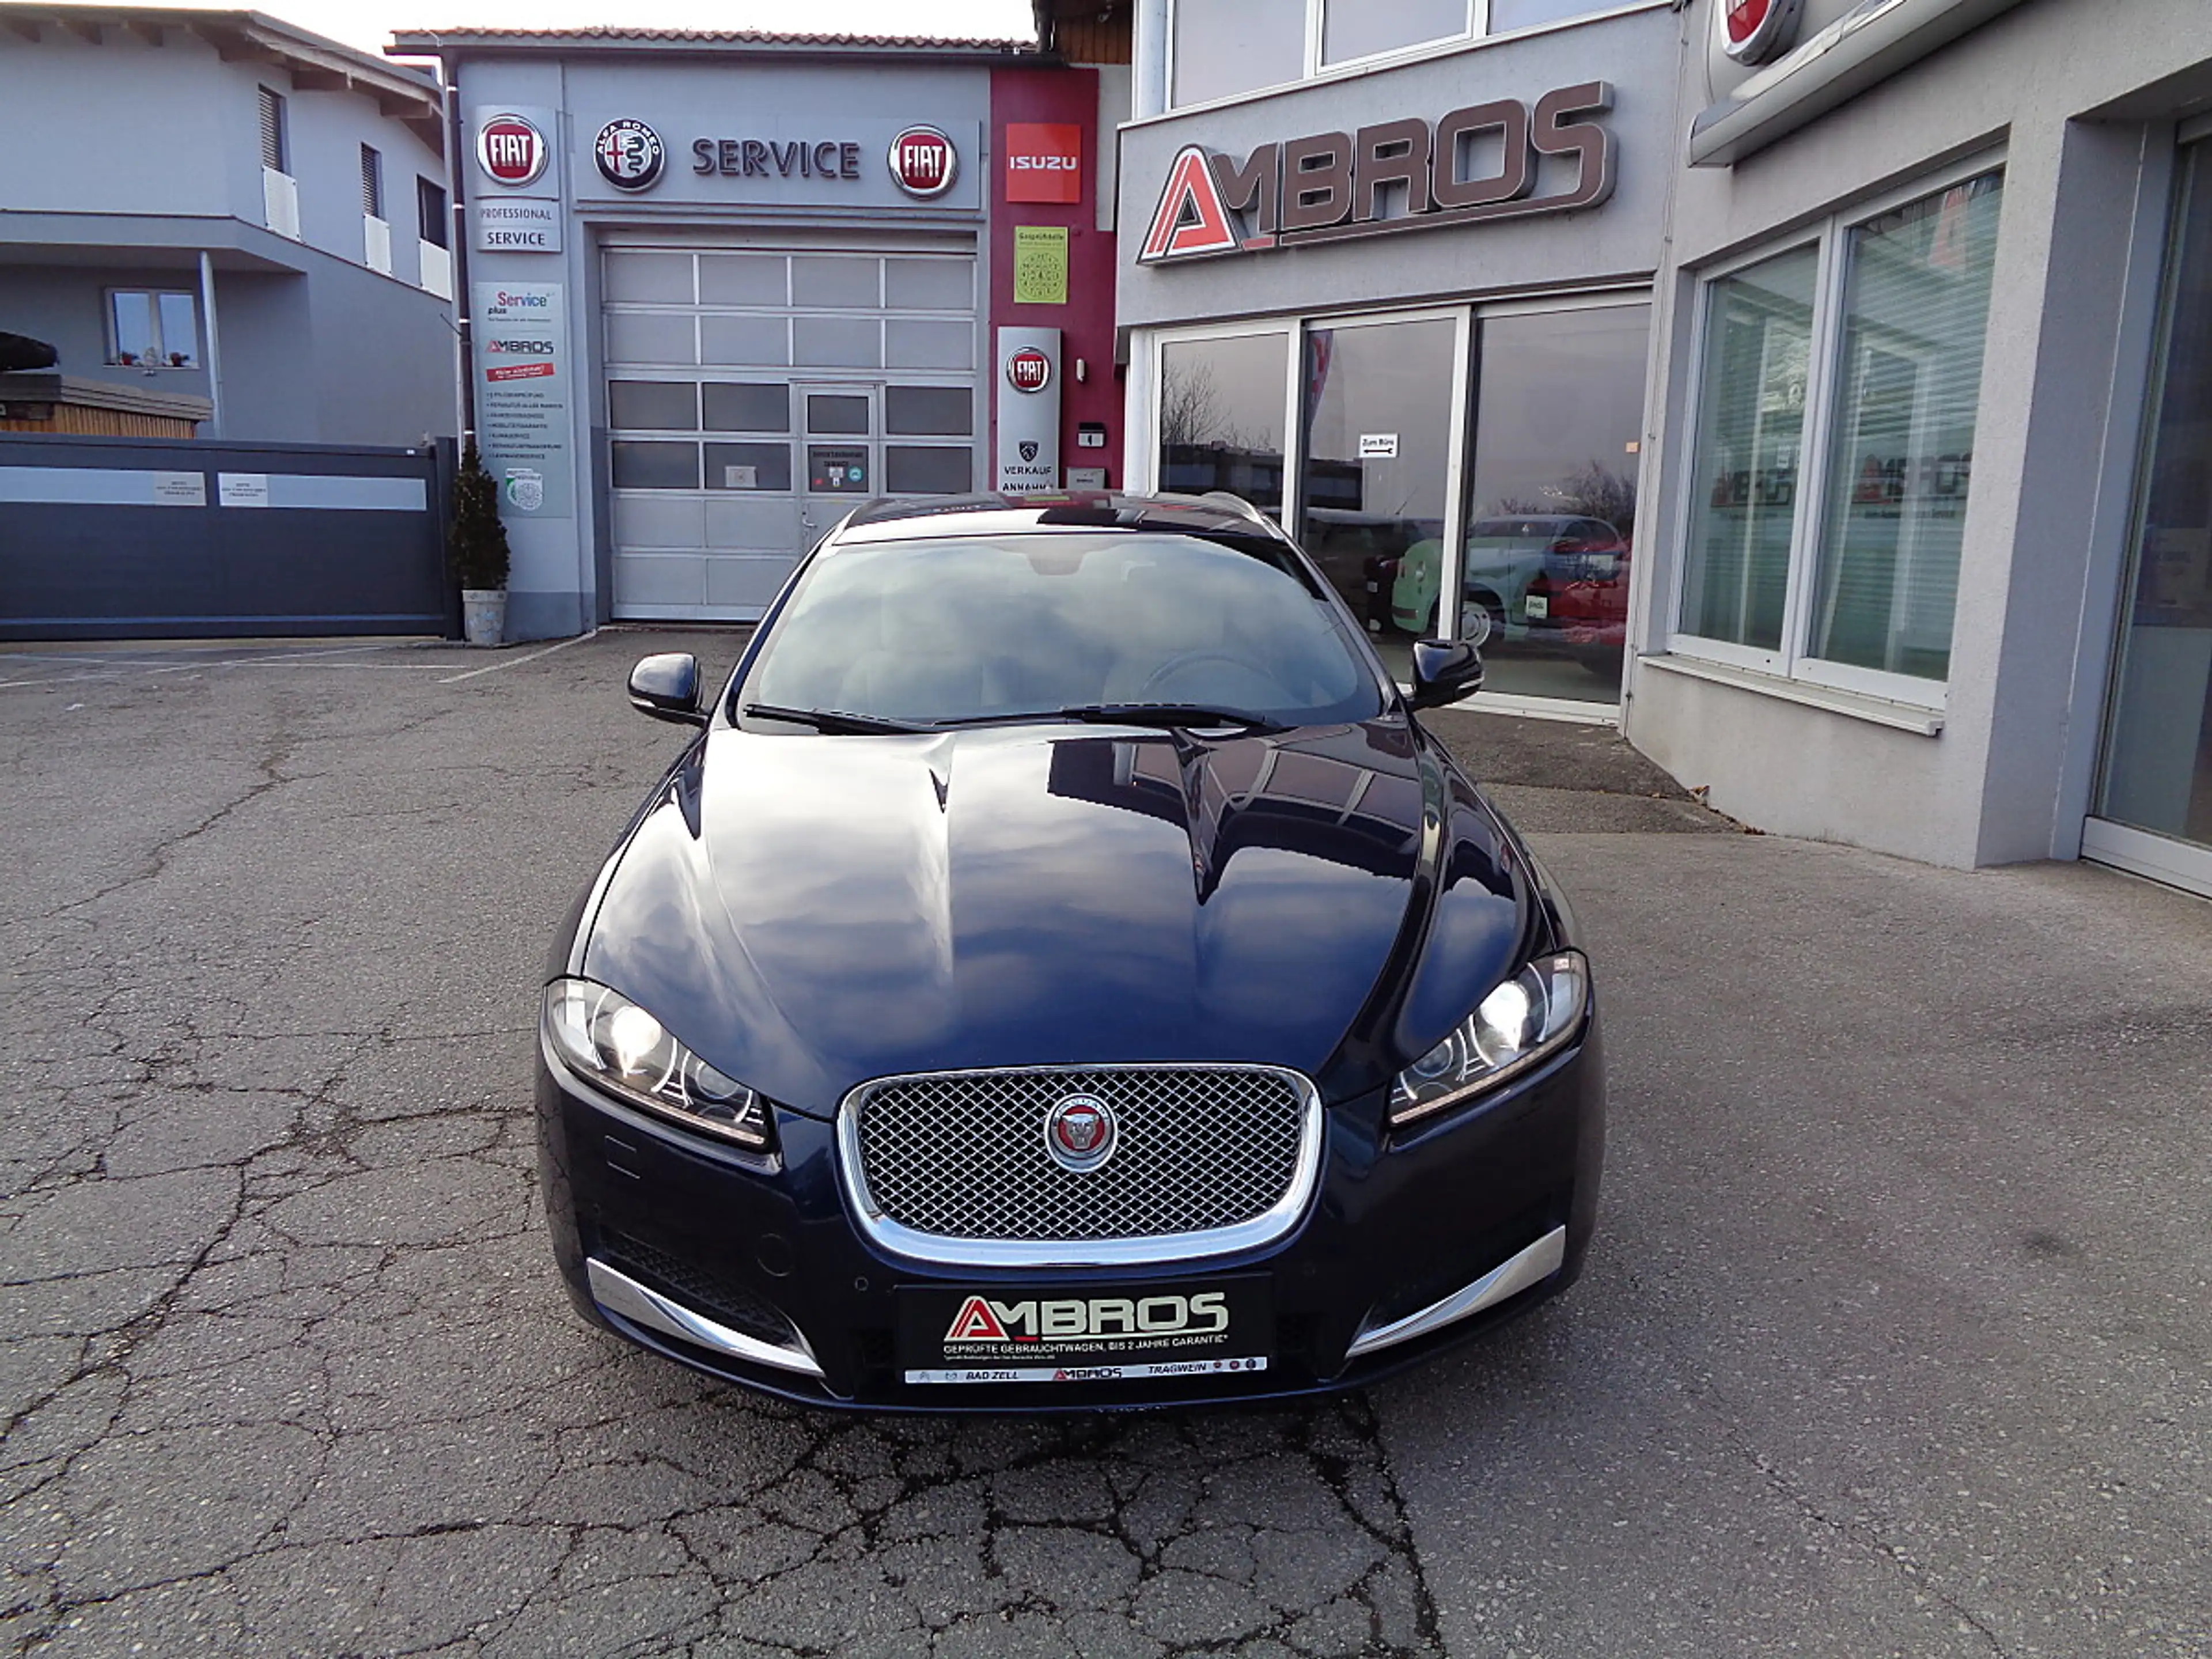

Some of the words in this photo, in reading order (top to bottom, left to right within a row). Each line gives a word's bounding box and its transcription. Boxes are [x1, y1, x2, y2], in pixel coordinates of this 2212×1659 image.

[598, 125, 618, 153] ALFA
[623, 122, 660, 154] ROMEO
[488, 133, 531, 166] FIAT
[692, 138, 861, 180] SERVICE
[904, 145, 944, 178] FIAT
[1009, 156, 1077, 171] ISUZU
[1136, 81, 1618, 267] AMBROS
[480, 208, 552, 220] PROFESSIONAL
[487, 232, 546, 246] SERVICE
[497, 290, 547, 306] Service
[486, 339, 554, 354] AMBROS
[1017, 360, 1043, 381] FIAT
[1005, 465, 1052, 475] VERKAUF
[944, 1291, 1229, 1342] AMBROS
[944, 1343, 999, 1354] GEPRÜFTE
[1127, 1340, 1135, 1350] 2
[1136, 1338, 1170, 1350] JAHRE
[965, 1371, 988, 1380] BAD
[991, 1370, 1018, 1380] ZELL
[1147, 1362, 1207, 1374] TRAGWEIN
